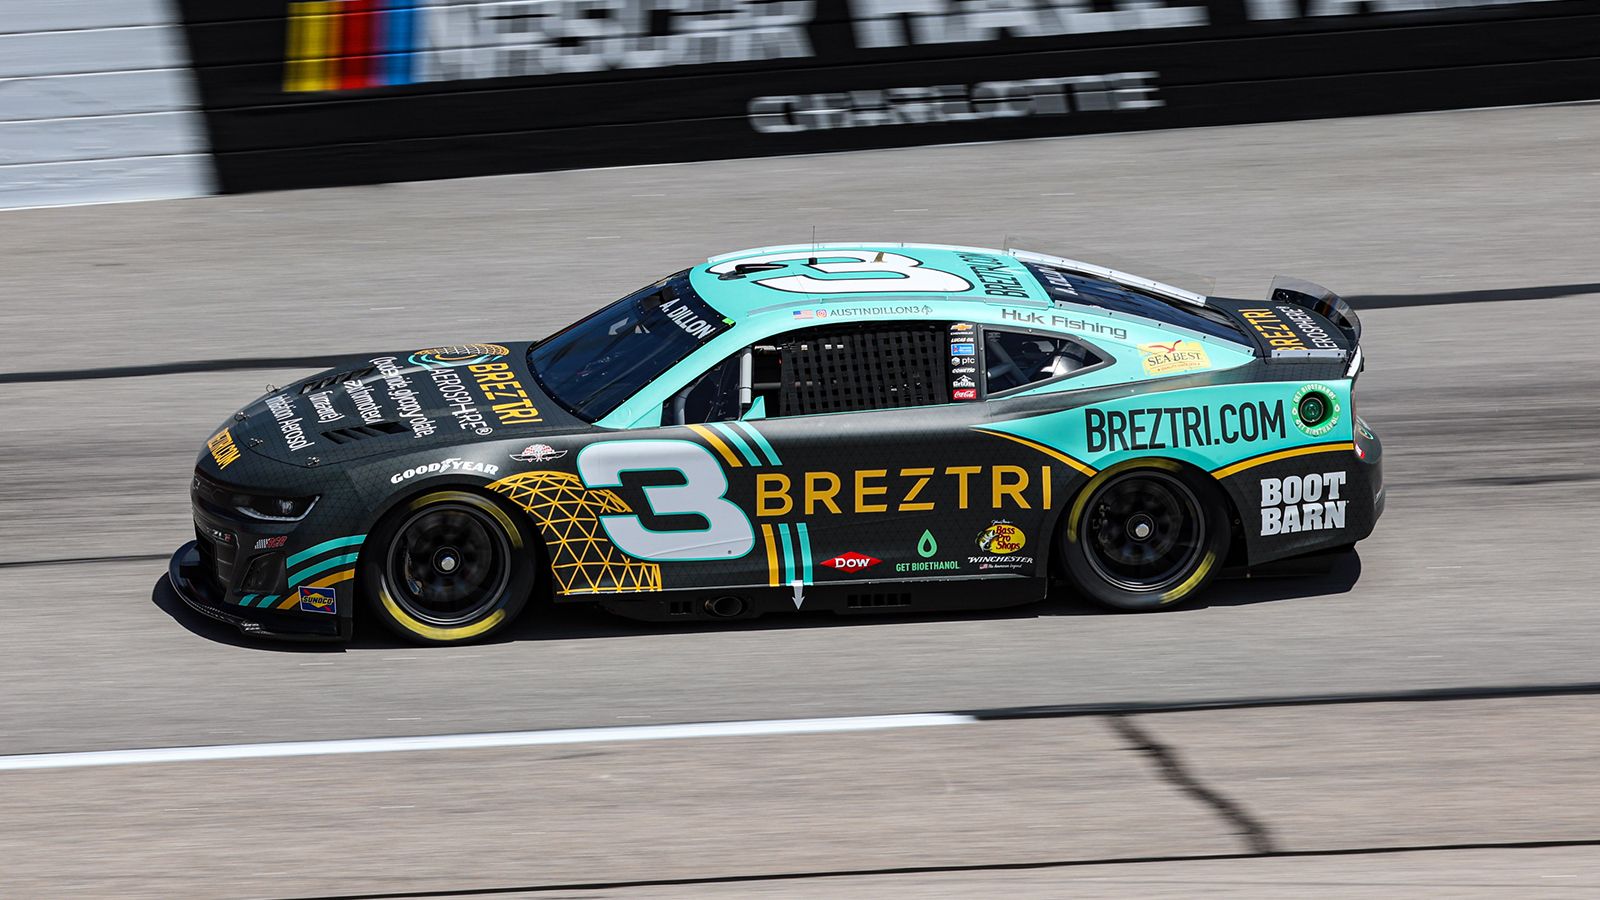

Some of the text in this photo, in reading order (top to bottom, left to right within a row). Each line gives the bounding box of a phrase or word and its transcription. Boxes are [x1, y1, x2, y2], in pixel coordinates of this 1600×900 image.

[659, 298, 717, 339] A. DILLON
[829, 306, 920, 317] AUSTINDILLON3
[1001, 308, 1128, 339] Huk Fishing
[961, 357, 976, 365] ptc
[1147, 354, 1171, 367] SEA
[1172, 351, 1201, 362] BEST
[467, 362, 543, 425] BREZTRI
[280, 416, 315, 452] Aerosol
[1084, 399, 1287, 453] BREZTRI.COM
[390, 457, 499, 484] GOODYEAR
[576, 439, 755, 562] 3
[756, 465, 1052, 518] BREZTRI
[1260, 471, 1347, 506] BOOT
[995, 525, 1016, 535] Bass
[1260, 501, 1347, 537] BARN
[995, 541, 1021, 551] Shops
[996, 534, 1011, 543] Pro
[895, 560, 960, 572] GET BIOETHANOL
[967, 556, 1034, 564] WINCHESTER
[303, 595, 335, 605] SUNOCO
